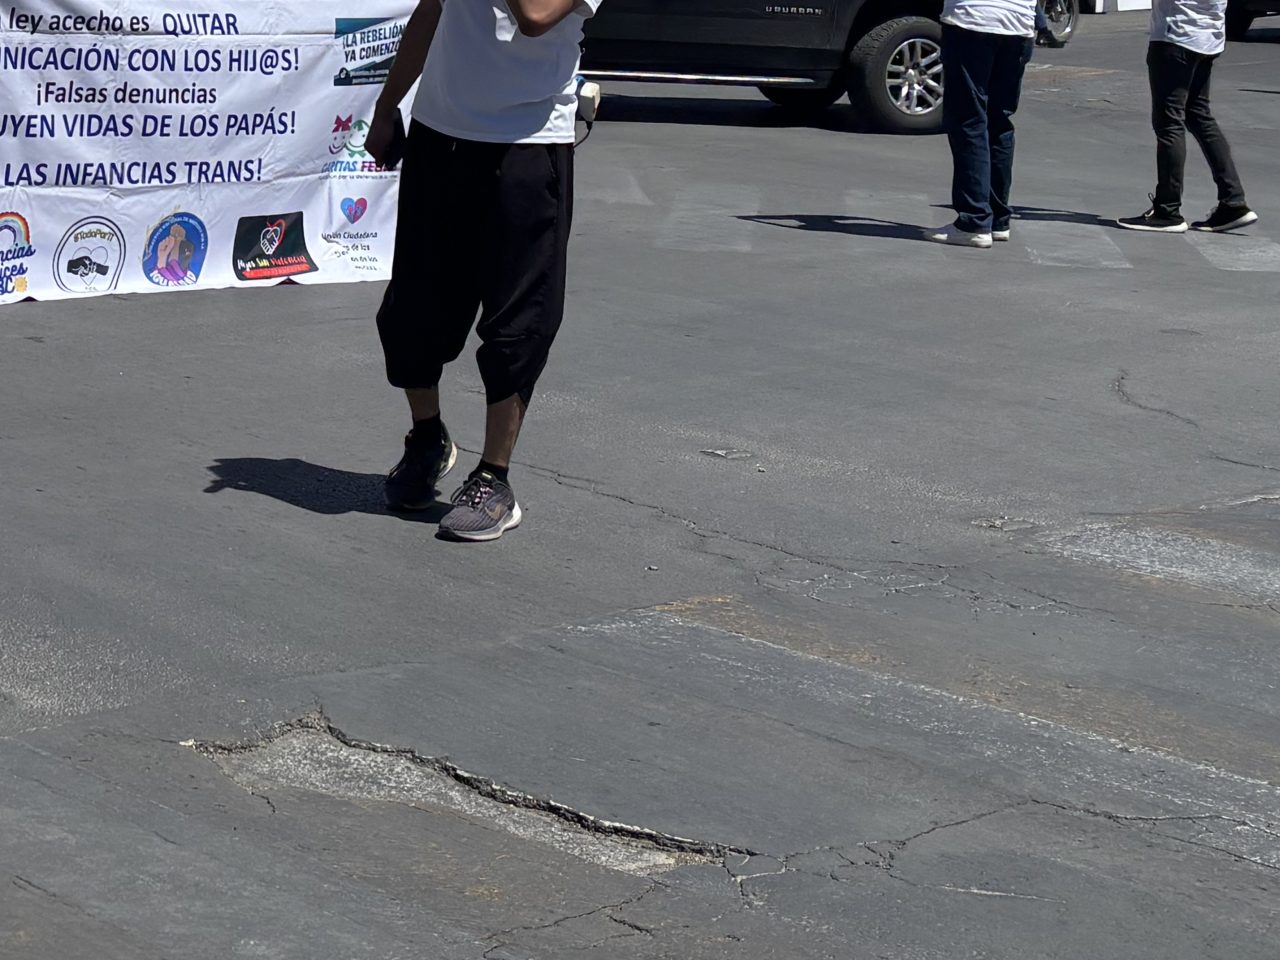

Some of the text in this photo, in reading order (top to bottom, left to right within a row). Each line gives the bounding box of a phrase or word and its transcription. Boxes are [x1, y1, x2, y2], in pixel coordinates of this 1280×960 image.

[9, 7, 43, 35] ley
[49, 10, 124, 33] acecho
[130, 15, 151, 32] es
[162, 12, 239, 37] QUITAR
[764, 5, 823, 15] UBURBAN
[127, 48, 176, 72] CON
[184, 49, 222, 73] LOS
[228, 48, 299, 76] HIJ@S!
[344, 49, 357, 63] YA
[36, 80, 217, 107] ¡Falsas denuncias
[62, 113, 135, 138] VIDAS
[141, 114, 173, 138] DE
[179, 114, 220, 137] LOS
[225, 106, 296, 137] PAPÁS!
[4, 162, 48, 187] LAS
[54, 161, 177, 186] INFANCIAS
[184, 157, 263, 184] TRANS!
